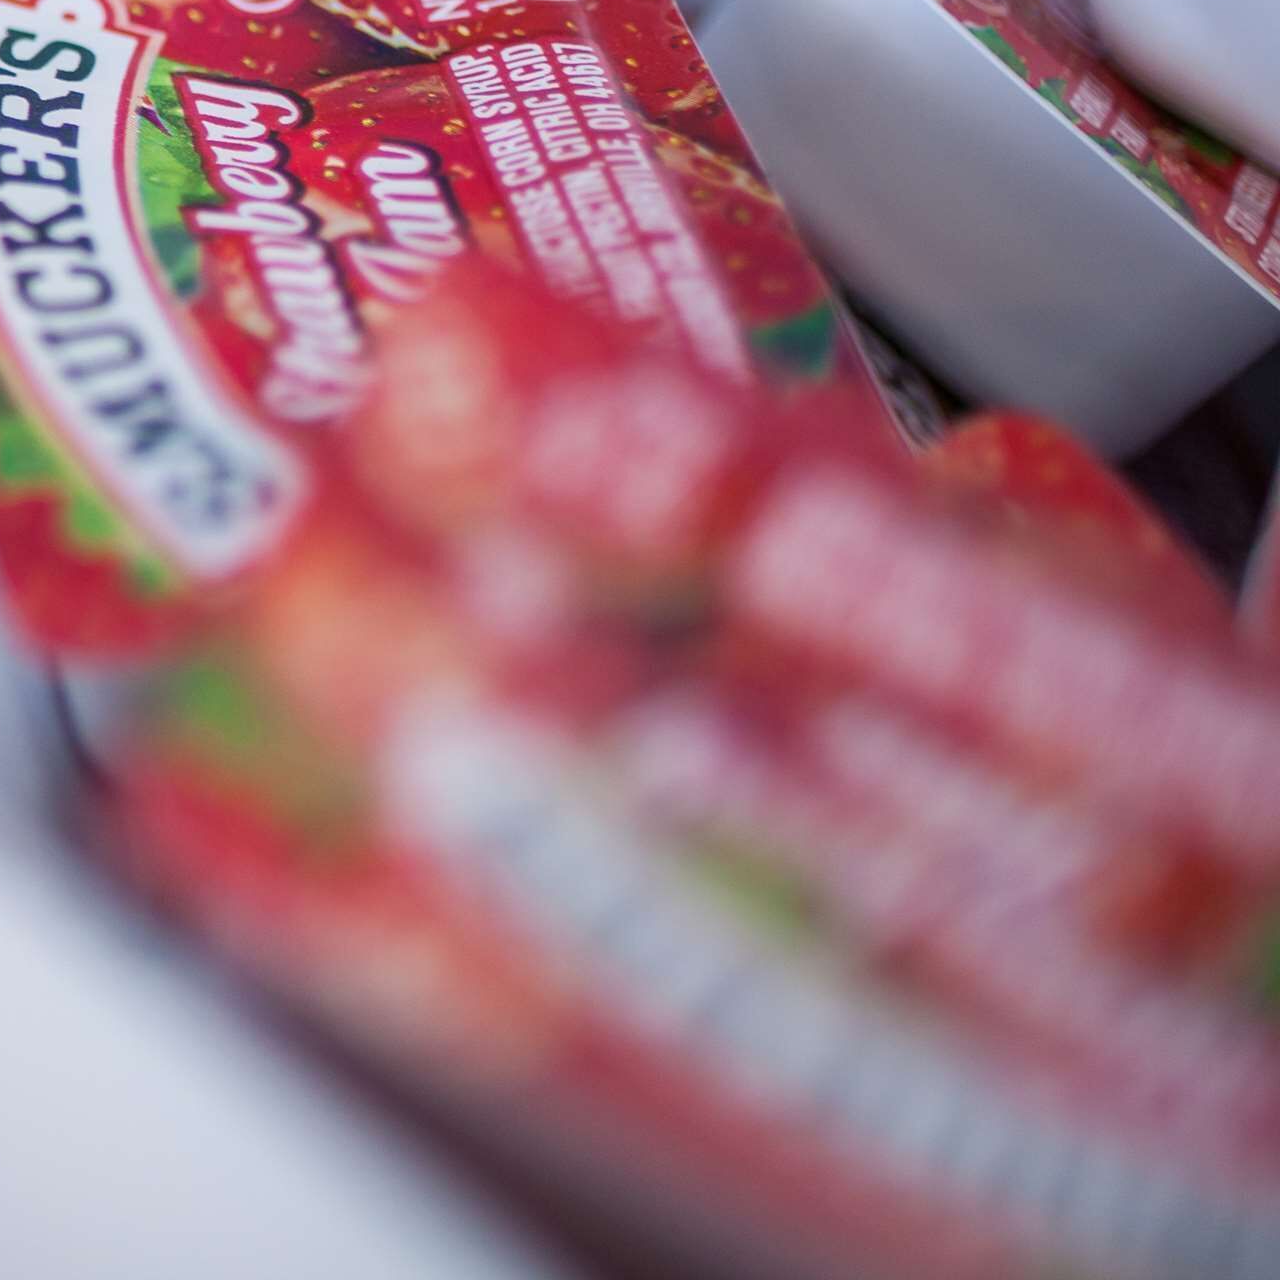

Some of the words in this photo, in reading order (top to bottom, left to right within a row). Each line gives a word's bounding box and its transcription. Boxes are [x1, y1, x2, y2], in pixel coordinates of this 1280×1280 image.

[449, 44, 517, 119] SYRUP,
[500, 43, 561, 92] ACID
[550, 42, 616, 99] 44667
[523, 93, 592, 162] CITRIC
[580, 103, 631, 131] OH
[481, 118, 546, 187] CORN
[183, 79, 362, 417] Strawberry
[346, 143, 460, 303] Jam
